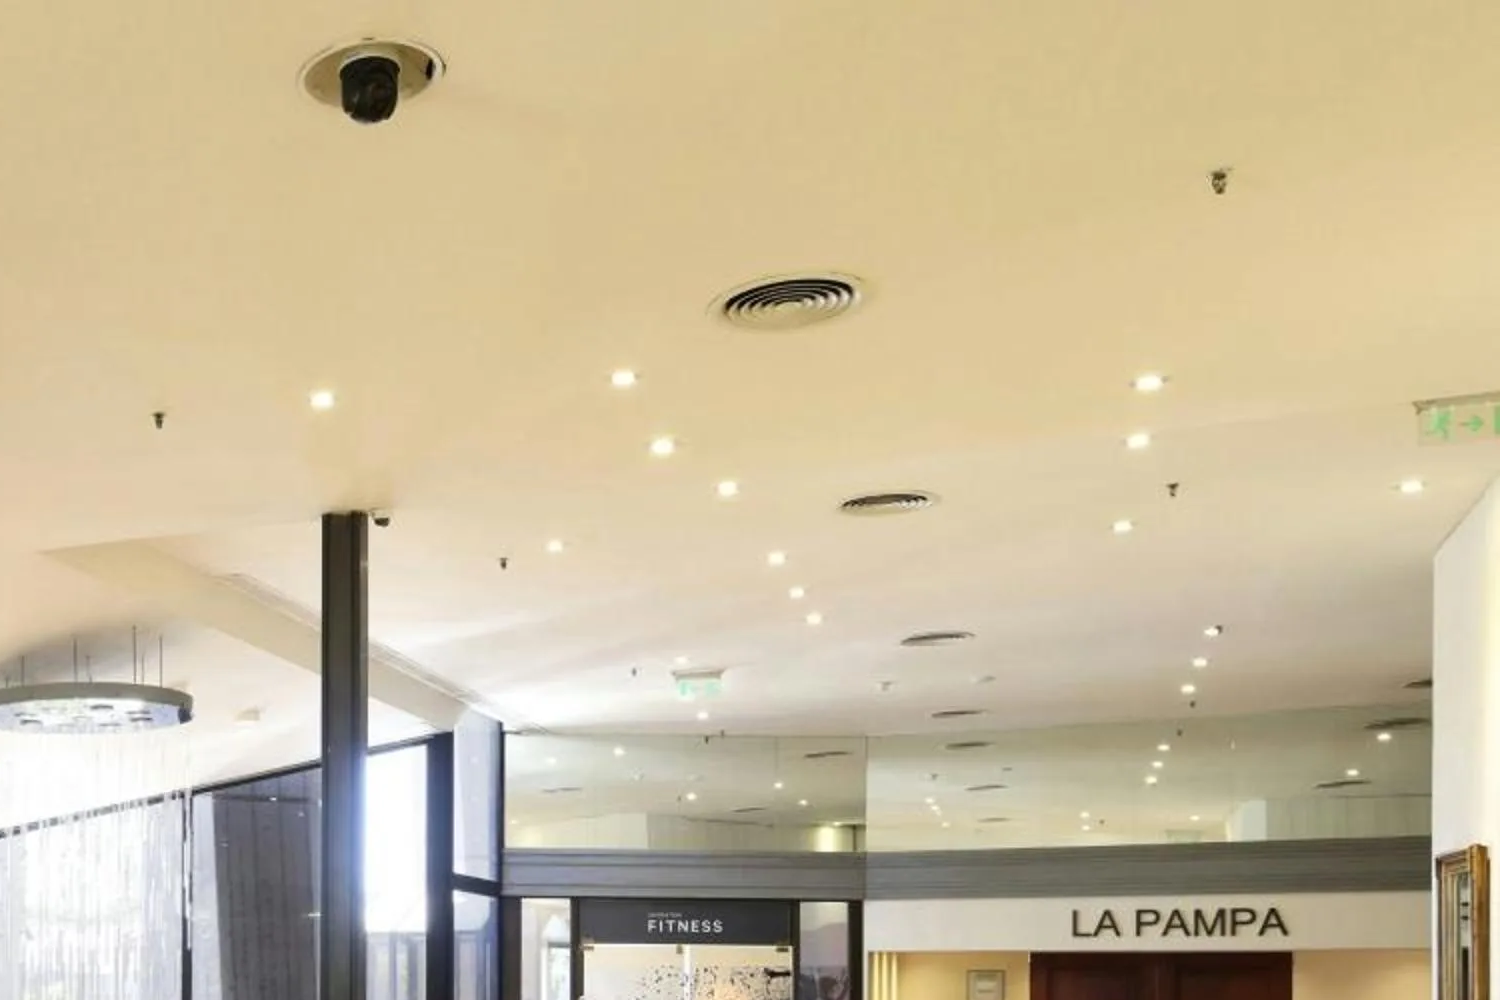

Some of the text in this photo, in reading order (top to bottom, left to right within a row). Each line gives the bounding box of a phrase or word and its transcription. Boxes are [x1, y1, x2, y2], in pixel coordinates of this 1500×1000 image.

[647, 919, 724, 934] FITNESS
[1071, 907, 1289, 938] LA PAMPA
